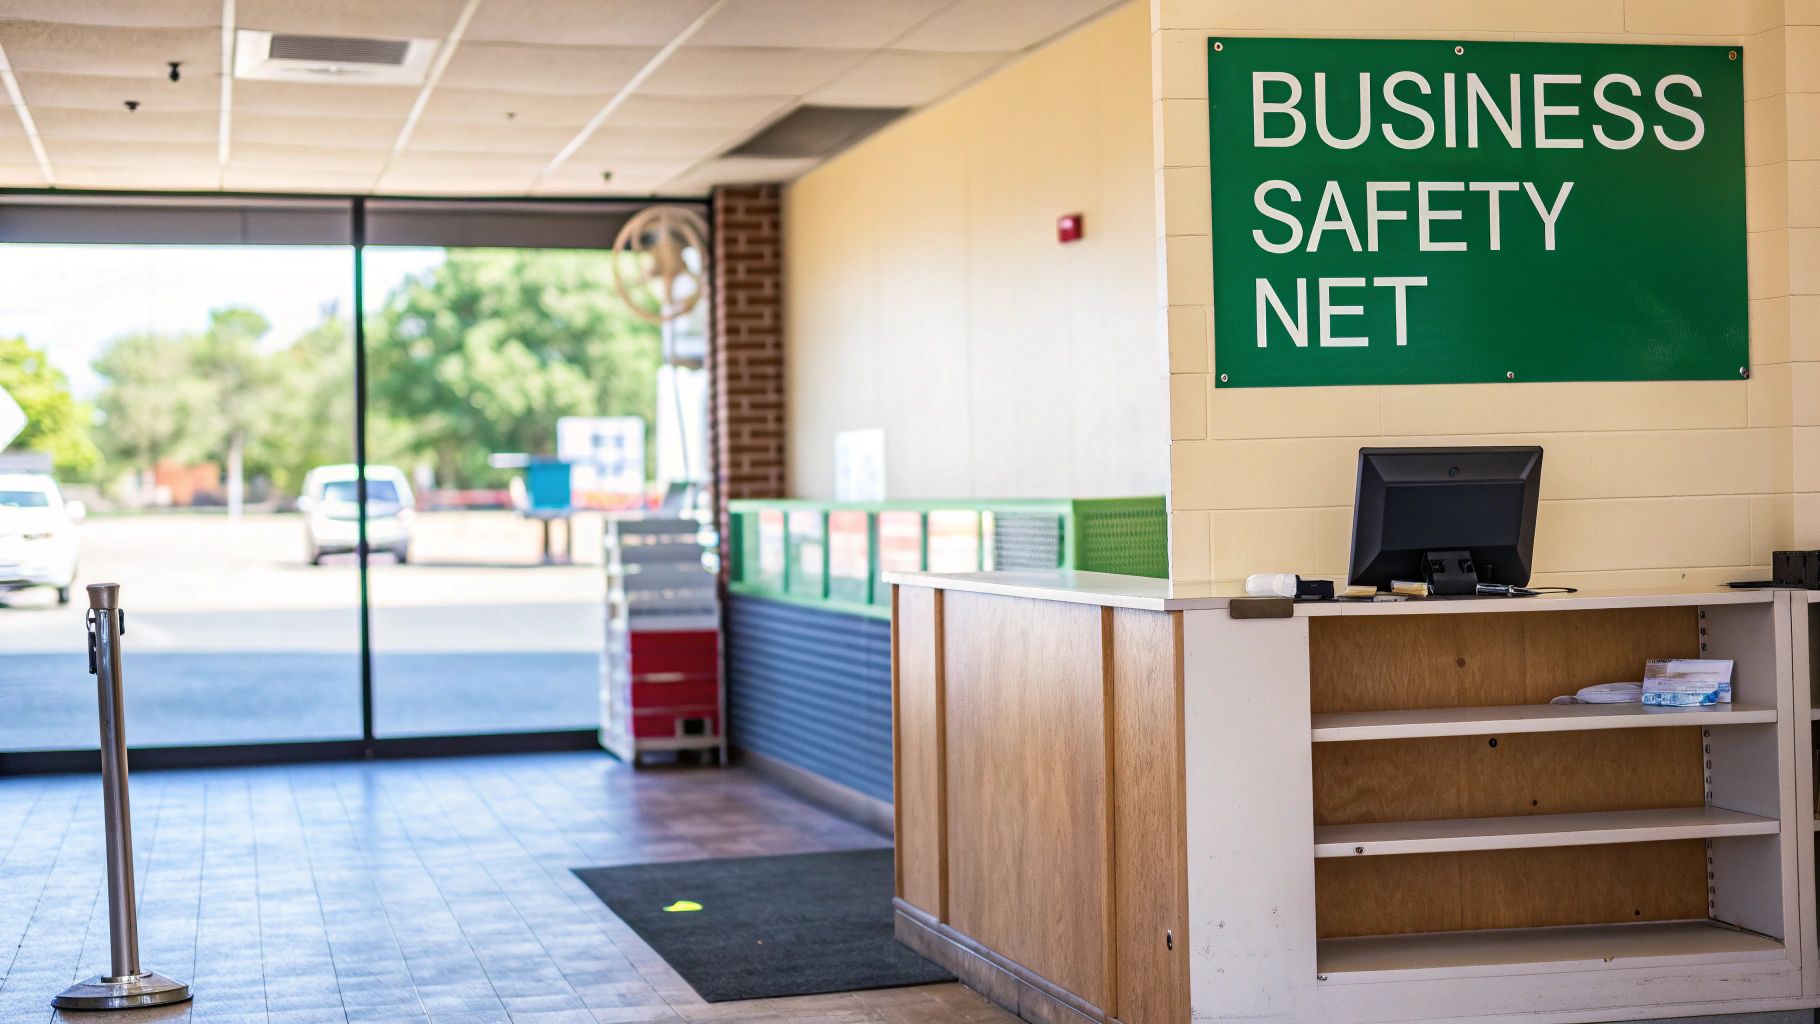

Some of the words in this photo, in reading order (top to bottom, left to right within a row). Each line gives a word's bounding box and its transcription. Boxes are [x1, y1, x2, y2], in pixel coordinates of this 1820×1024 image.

[1252, 71, 1705, 151] BUSINESS
[1252, 180, 1574, 254] SAFETY
[1255, 276, 1428, 348] NET
